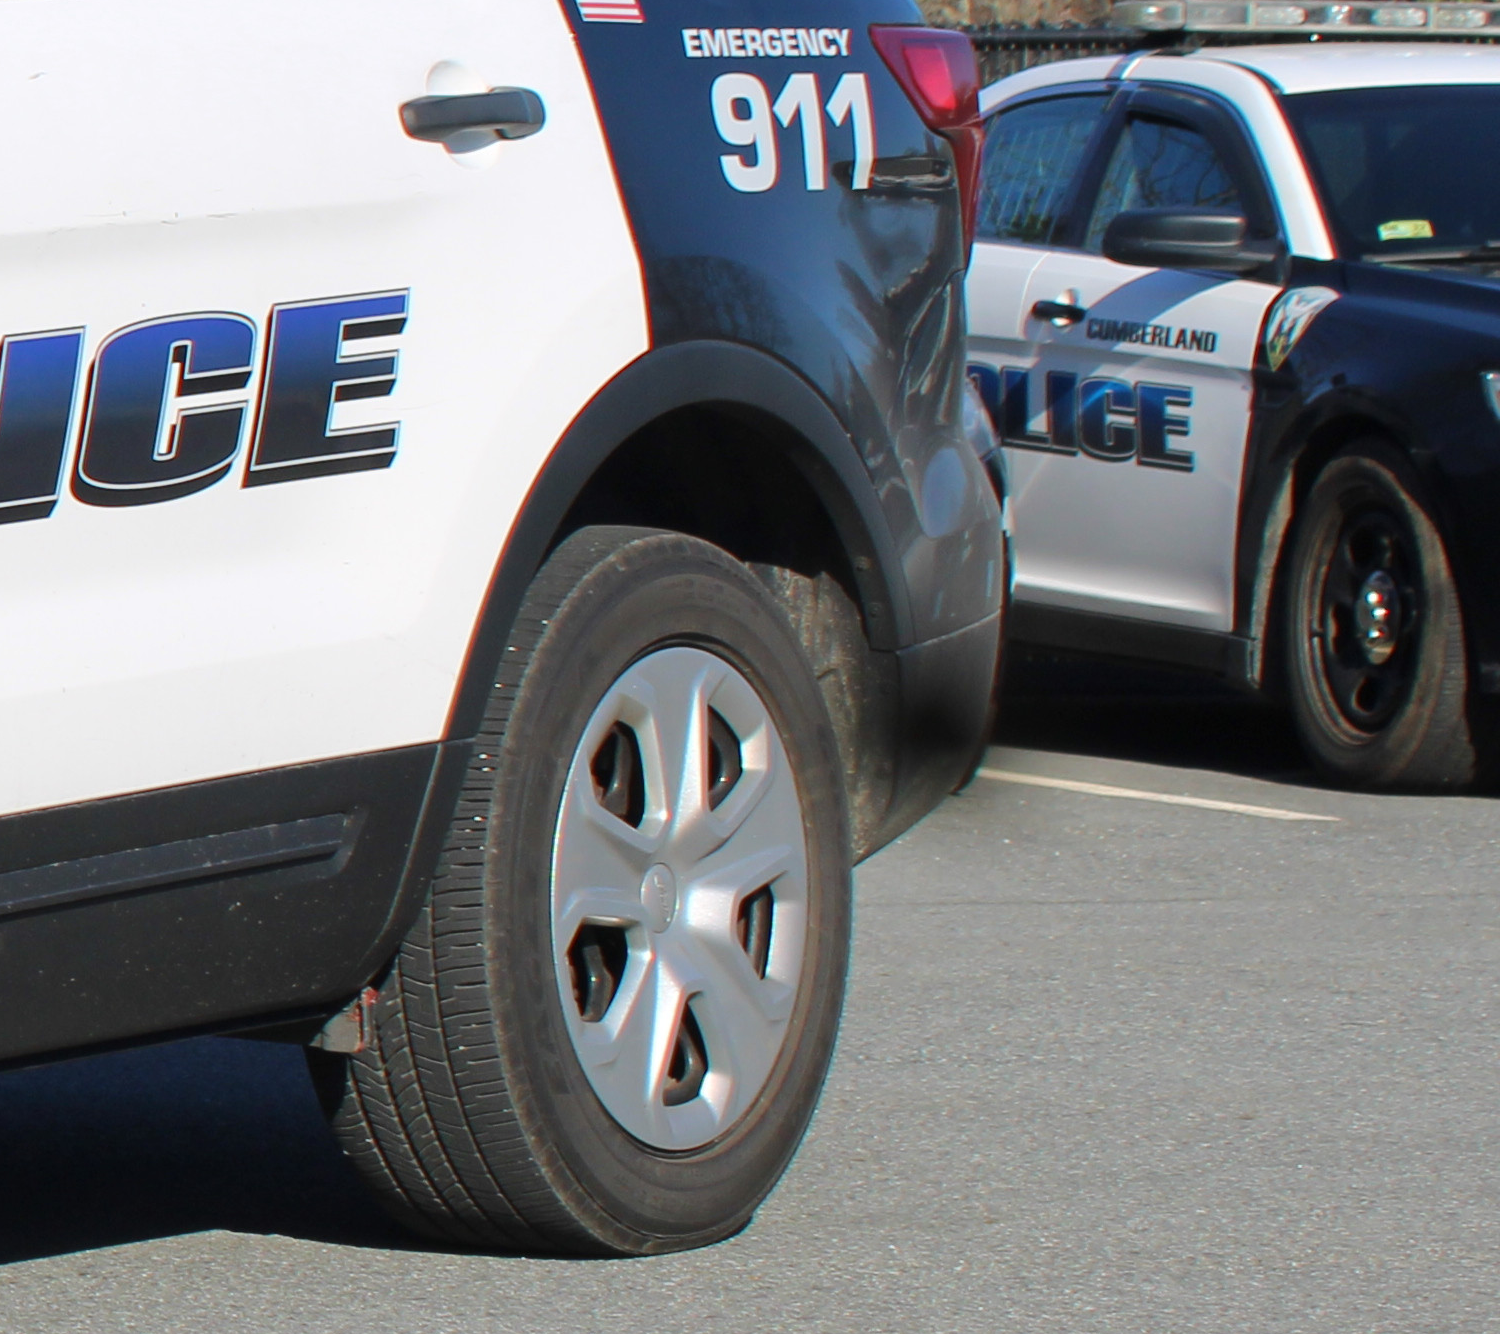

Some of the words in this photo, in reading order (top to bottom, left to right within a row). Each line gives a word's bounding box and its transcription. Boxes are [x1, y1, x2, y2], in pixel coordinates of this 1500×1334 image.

[682, 27, 852, 59] EMERGENCY
[710, 72, 877, 192] 911
[1086, 317, 1219, 354] CUMBERLAND
